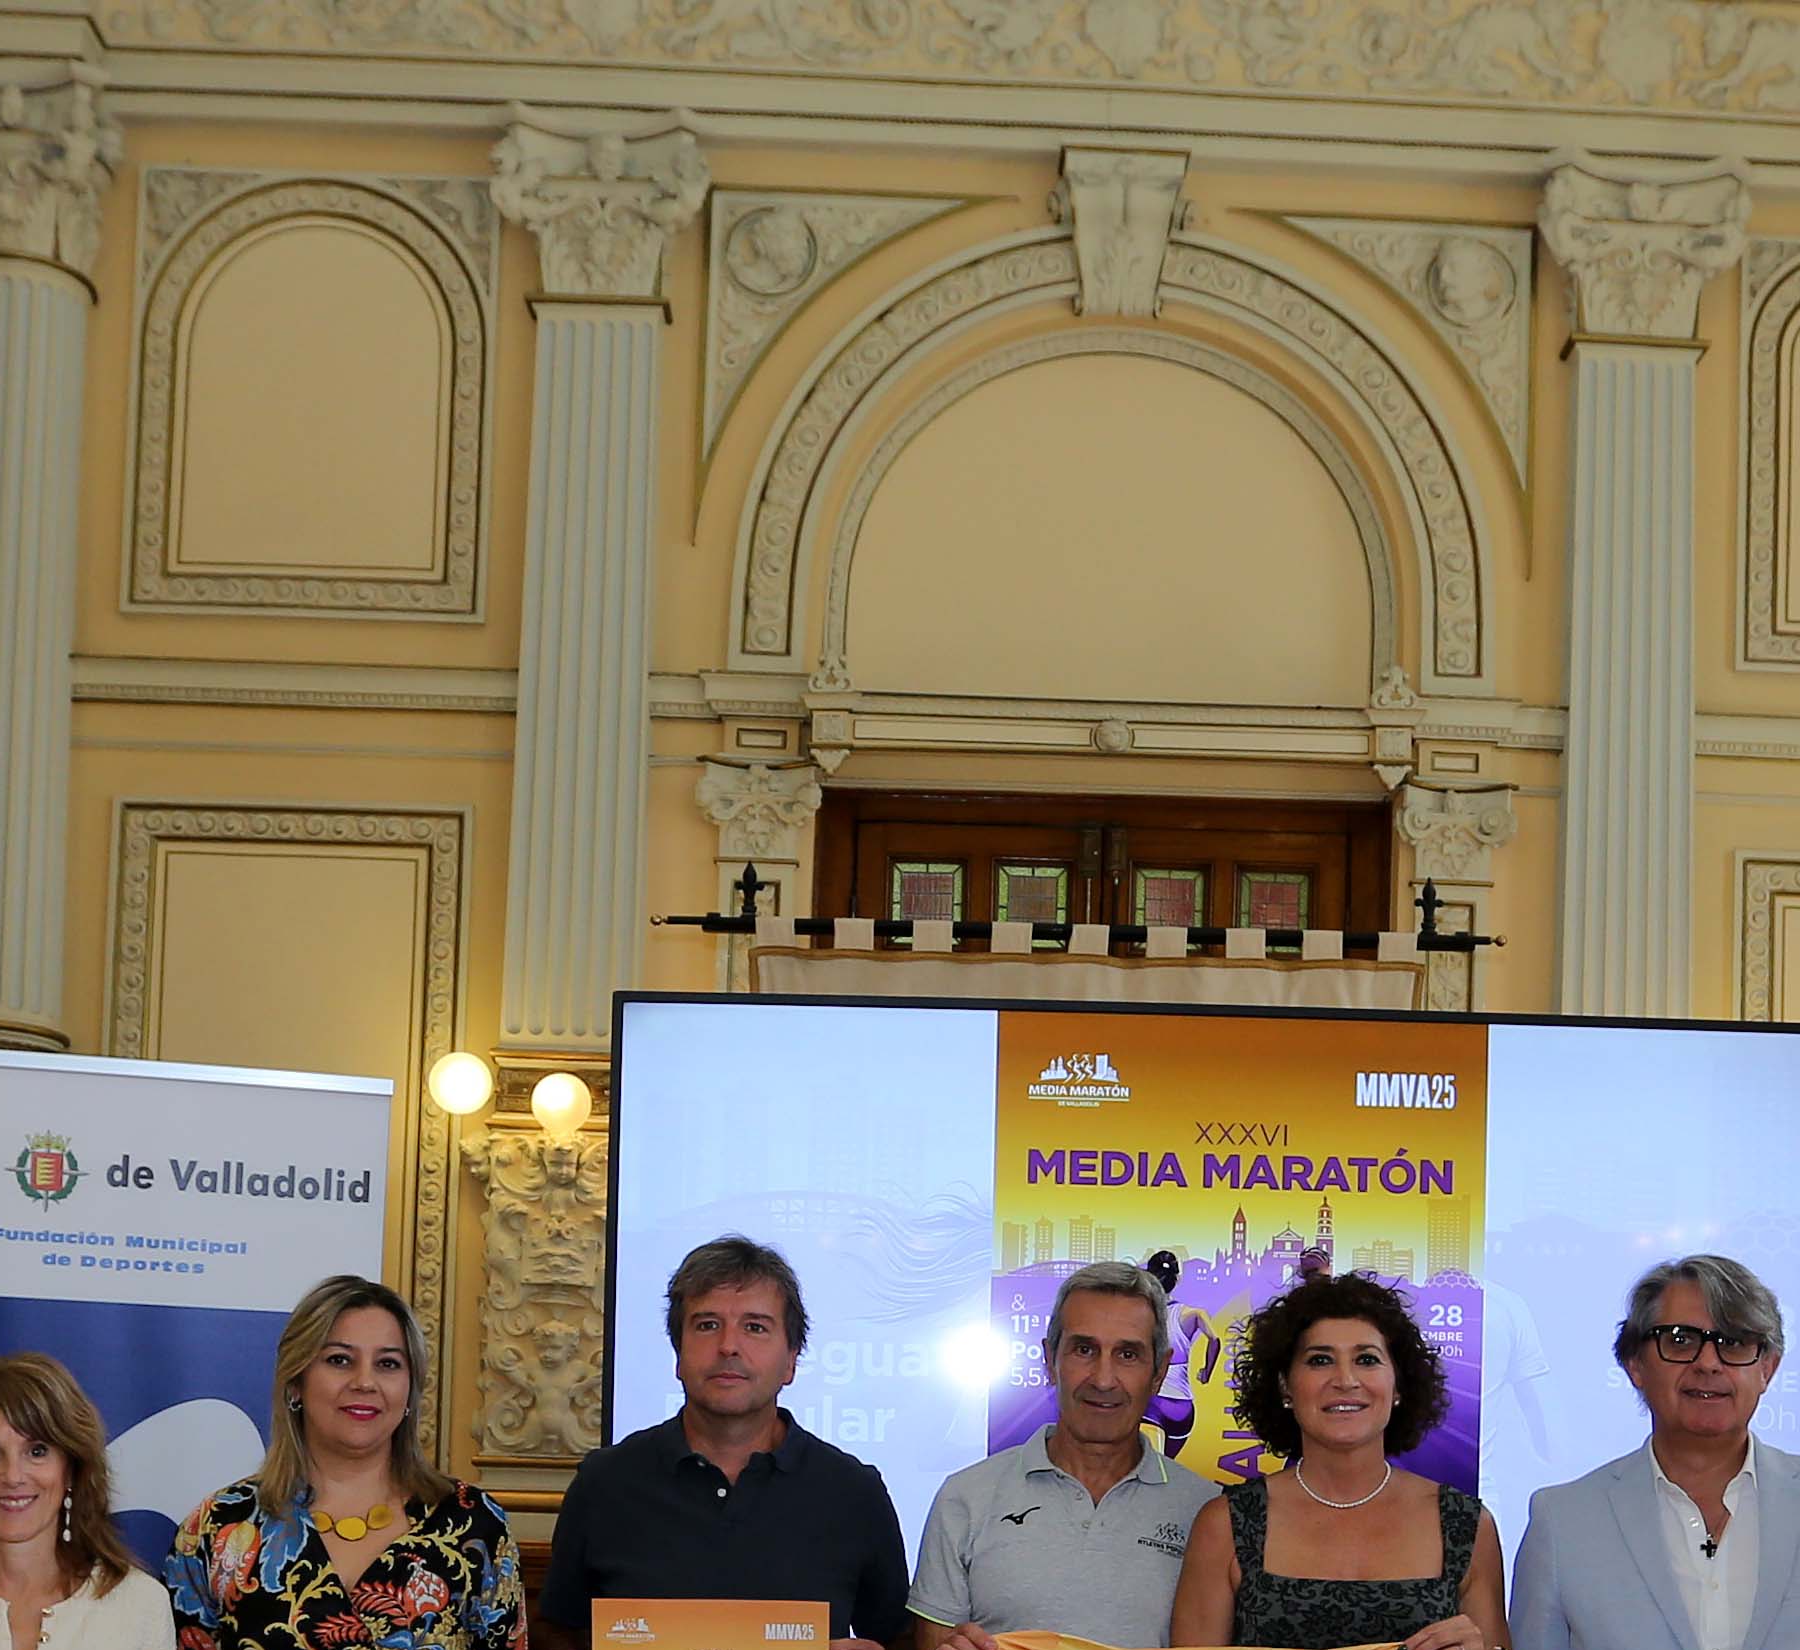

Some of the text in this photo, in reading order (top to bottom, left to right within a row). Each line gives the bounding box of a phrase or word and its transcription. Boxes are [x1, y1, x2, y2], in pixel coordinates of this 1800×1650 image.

[1028, 1083, 1130, 1098] MEDIA MARATÓN
[1356, 1072, 1455, 1110] MMVA25
[1195, 1122, 1289, 1147] XXXVI
[106, 1155, 154, 1191] de
[170, 1158, 371, 1203] Valladolid
[1028, 1148, 1454, 1195] MEDIA MARATÓN
[125, 1233, 248, 1256] Municipal
[42, 1252, 205, 1275] de Deportes
[1012, 1294, 1026, 1311] &
[1429, 1305, 1462, 1326] 28
[794, 1335, 931, 1384] egua
[765, 1623, 815, 1641] MMVA25
